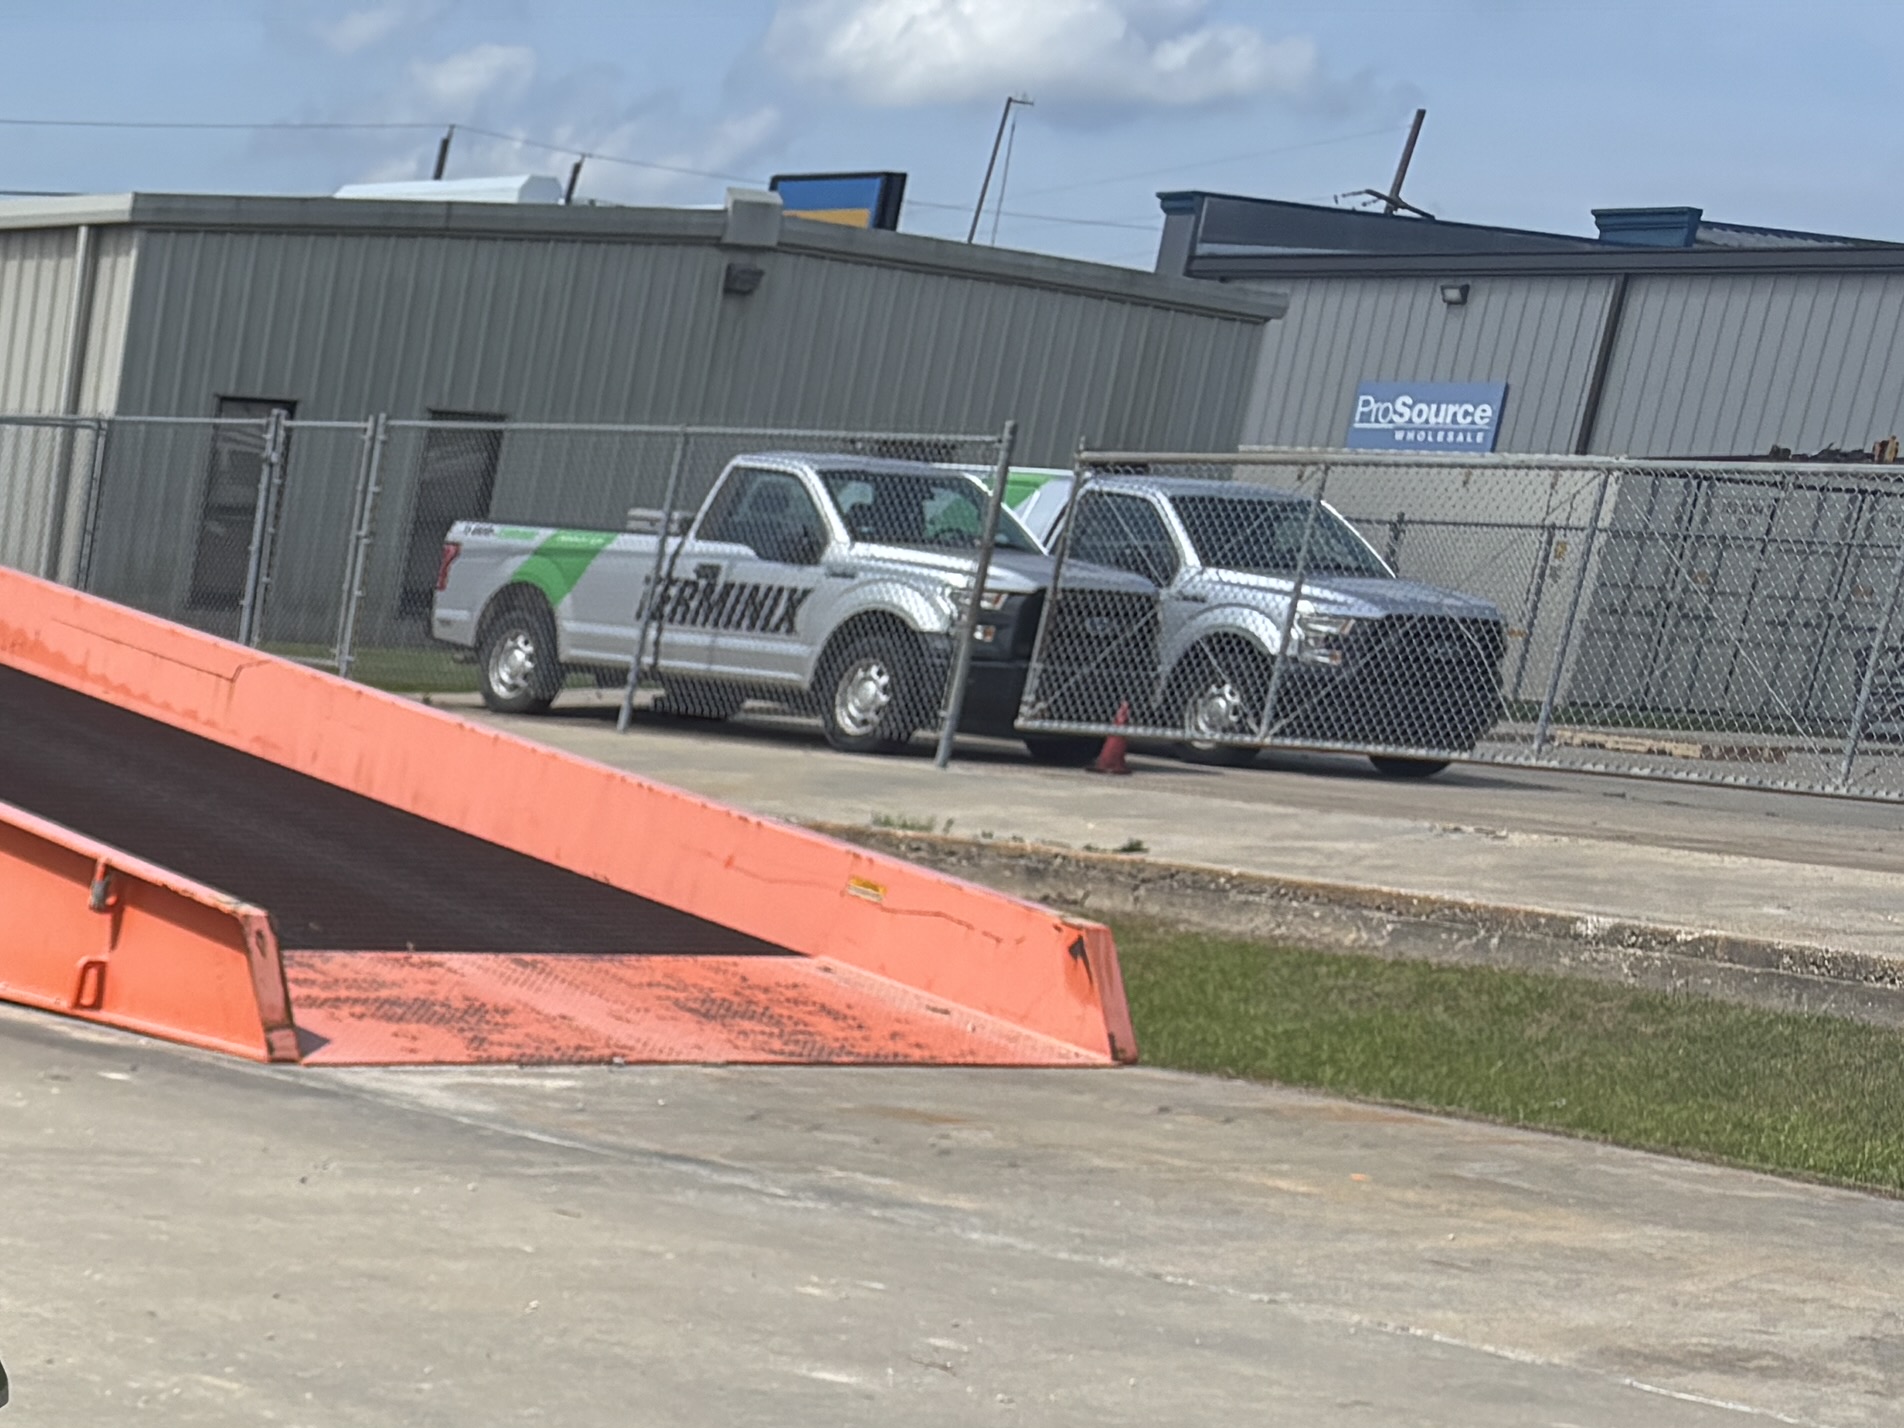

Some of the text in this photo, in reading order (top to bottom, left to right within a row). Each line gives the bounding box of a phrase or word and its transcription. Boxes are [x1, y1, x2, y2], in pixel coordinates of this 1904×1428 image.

[1354, 394, 1492, 425] ProSource
[1394, 430, 1485, 444] WHOLESALE
[635, 574, 814, 634] TERMINIX
